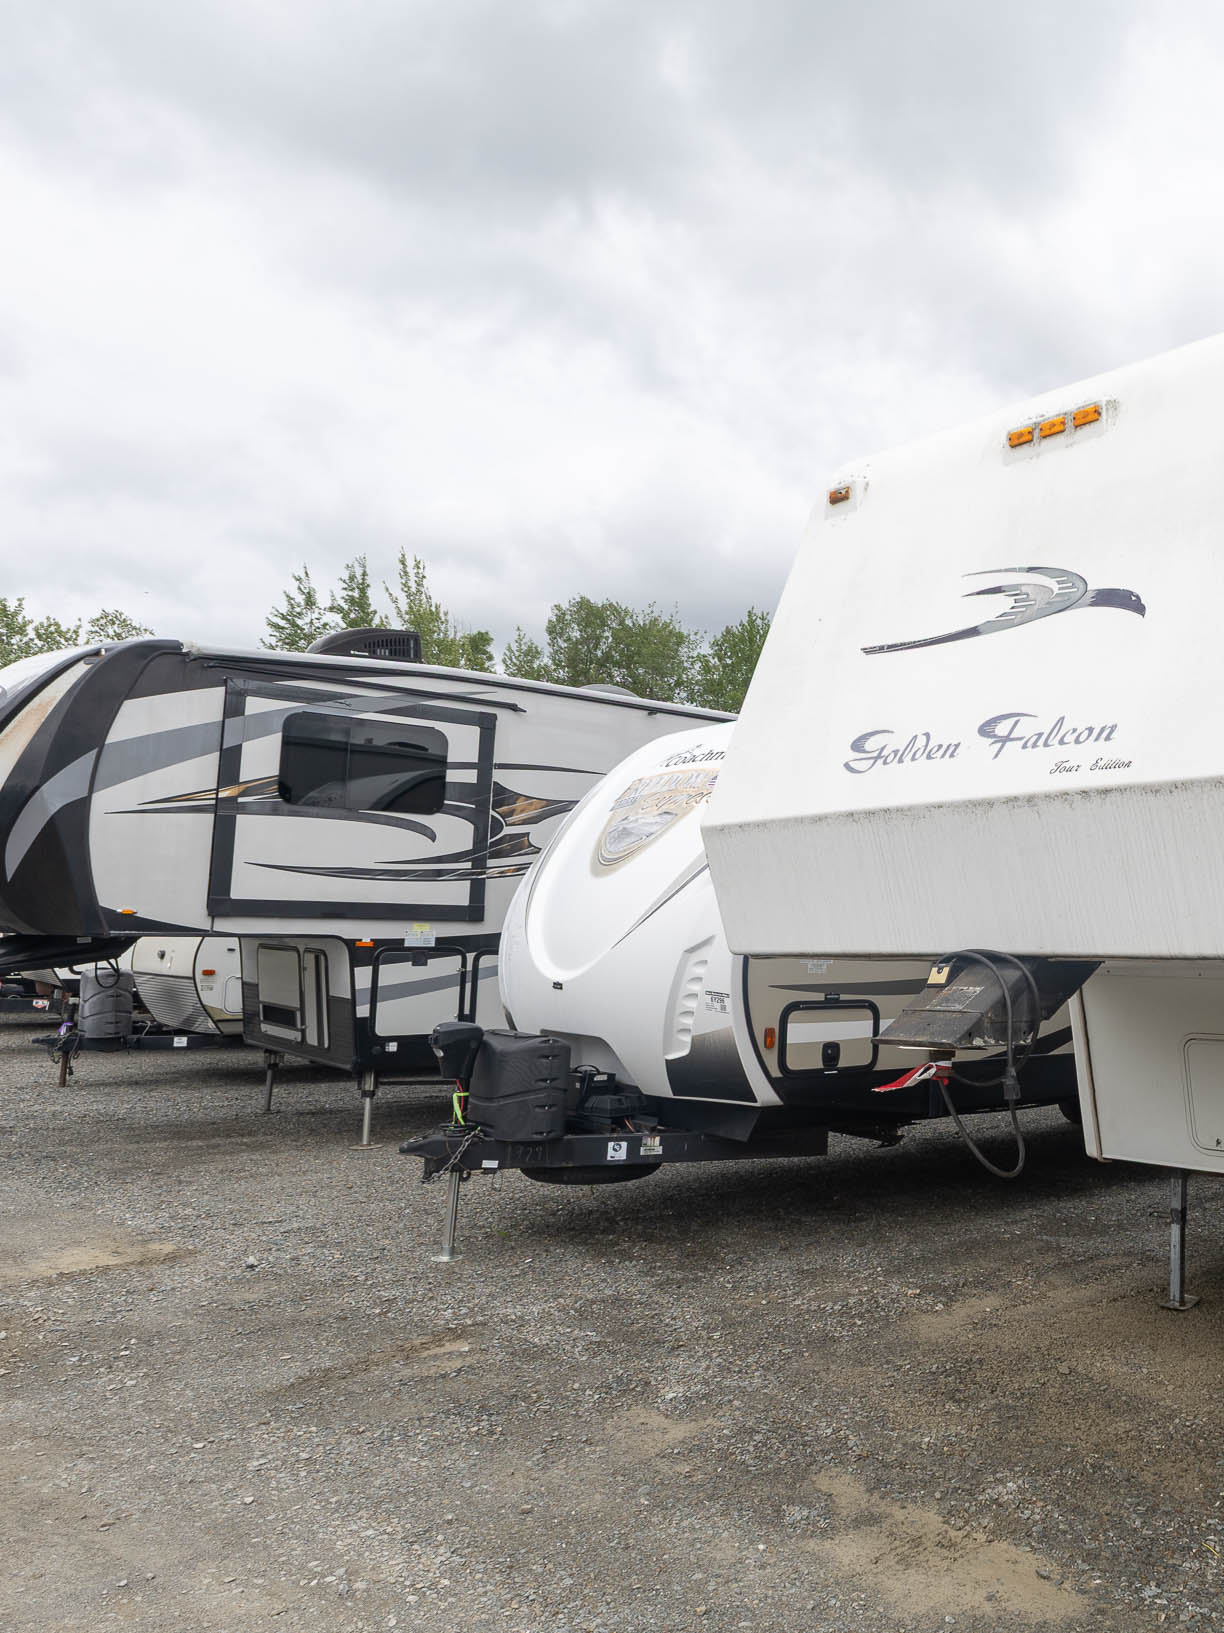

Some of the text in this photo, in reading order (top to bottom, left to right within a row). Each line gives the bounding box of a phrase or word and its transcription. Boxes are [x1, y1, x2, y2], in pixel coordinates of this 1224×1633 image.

[843, 712, 1118, 774] Golden Falcon
[1050, 757, 1133, 774] Tour Edition
